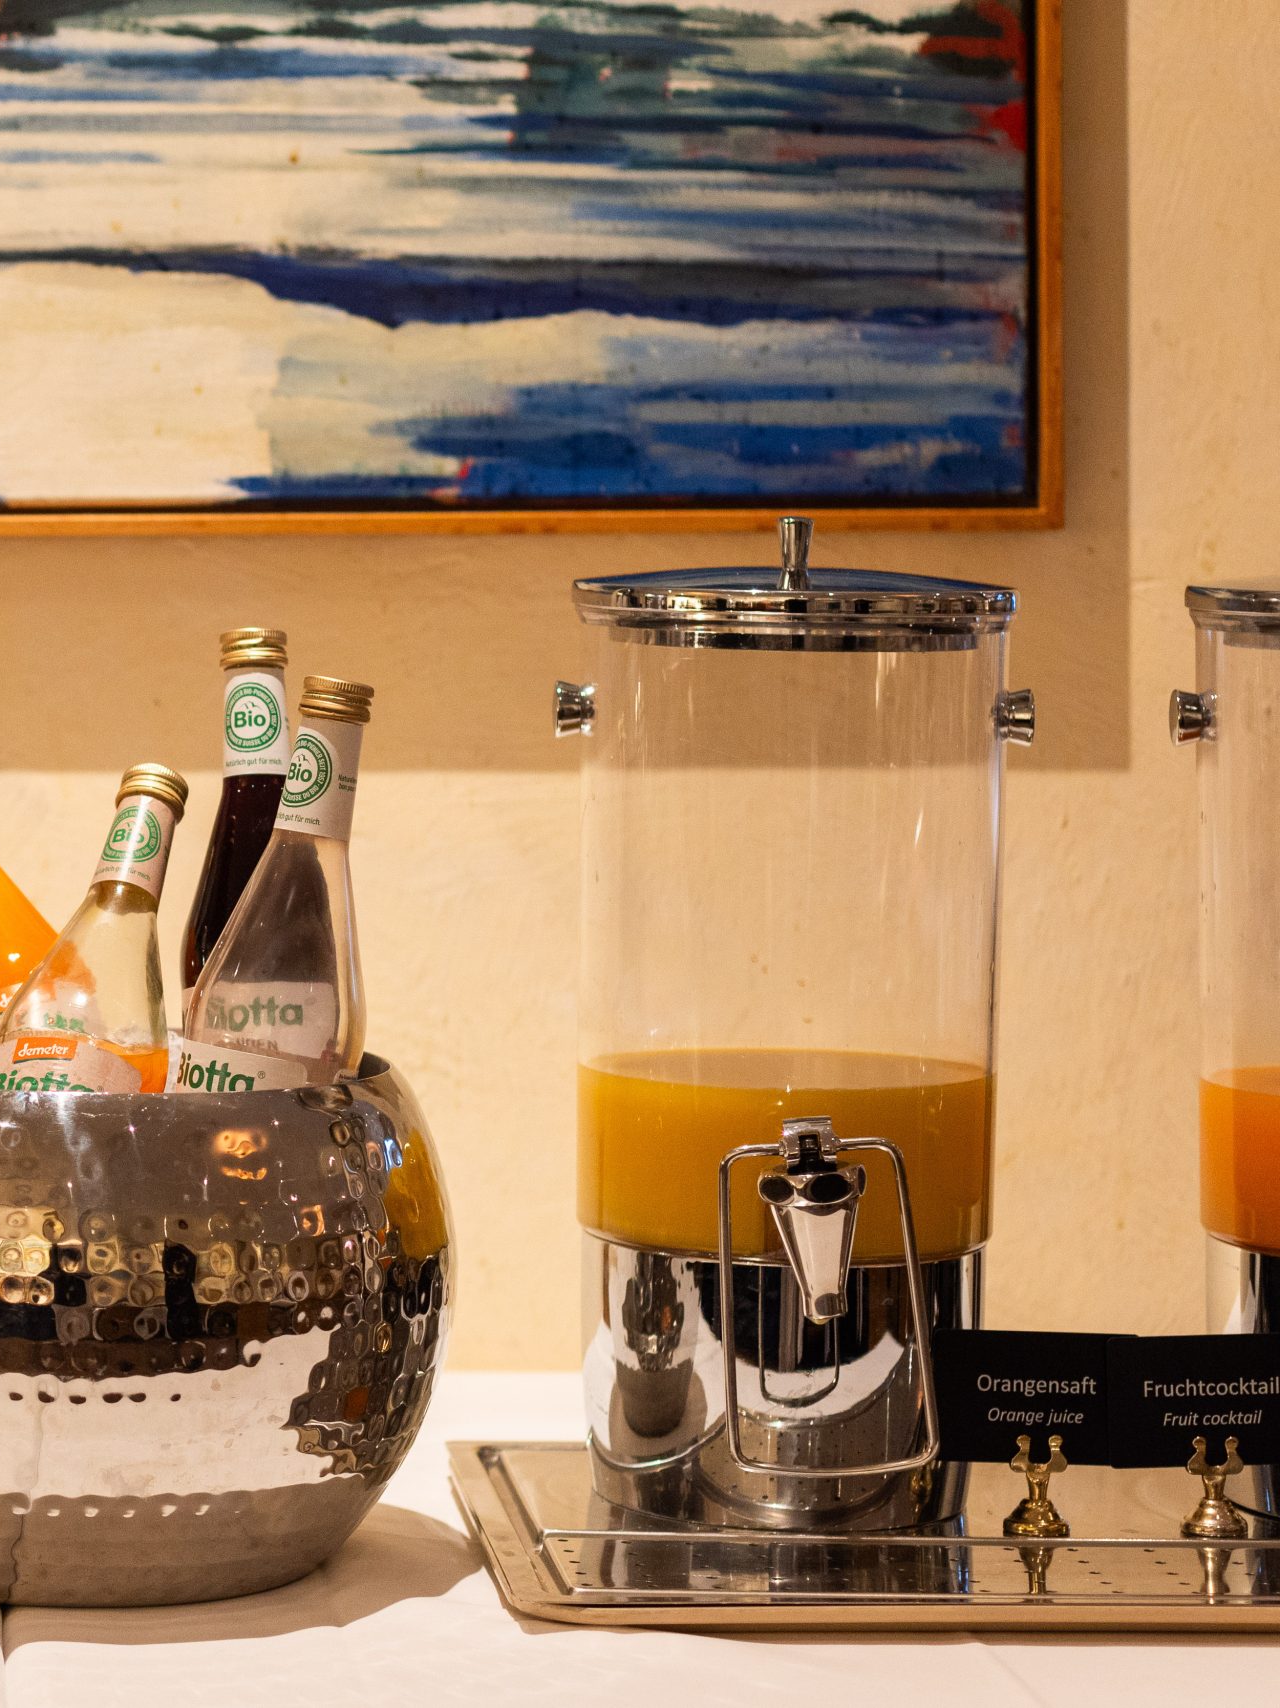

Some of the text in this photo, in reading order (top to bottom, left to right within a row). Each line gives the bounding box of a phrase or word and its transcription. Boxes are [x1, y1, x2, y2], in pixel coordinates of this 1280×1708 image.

[234, 710, 266, 728] Bio
[287, 762, 313, 782] Bio
[294, 814, 304, 823] für
[111, 828, 145, 843] Bio
[18, 1043, 70, 1057] demeter
[977, 1374, 1097, 1397] Orangensaft
[1143, 1376, 1280, 1398] Fruchtcocktail
[987, 1407, 1084, 1427] Orange juice
[1163, 1409, 1263, 1427] Fruit cocktail
